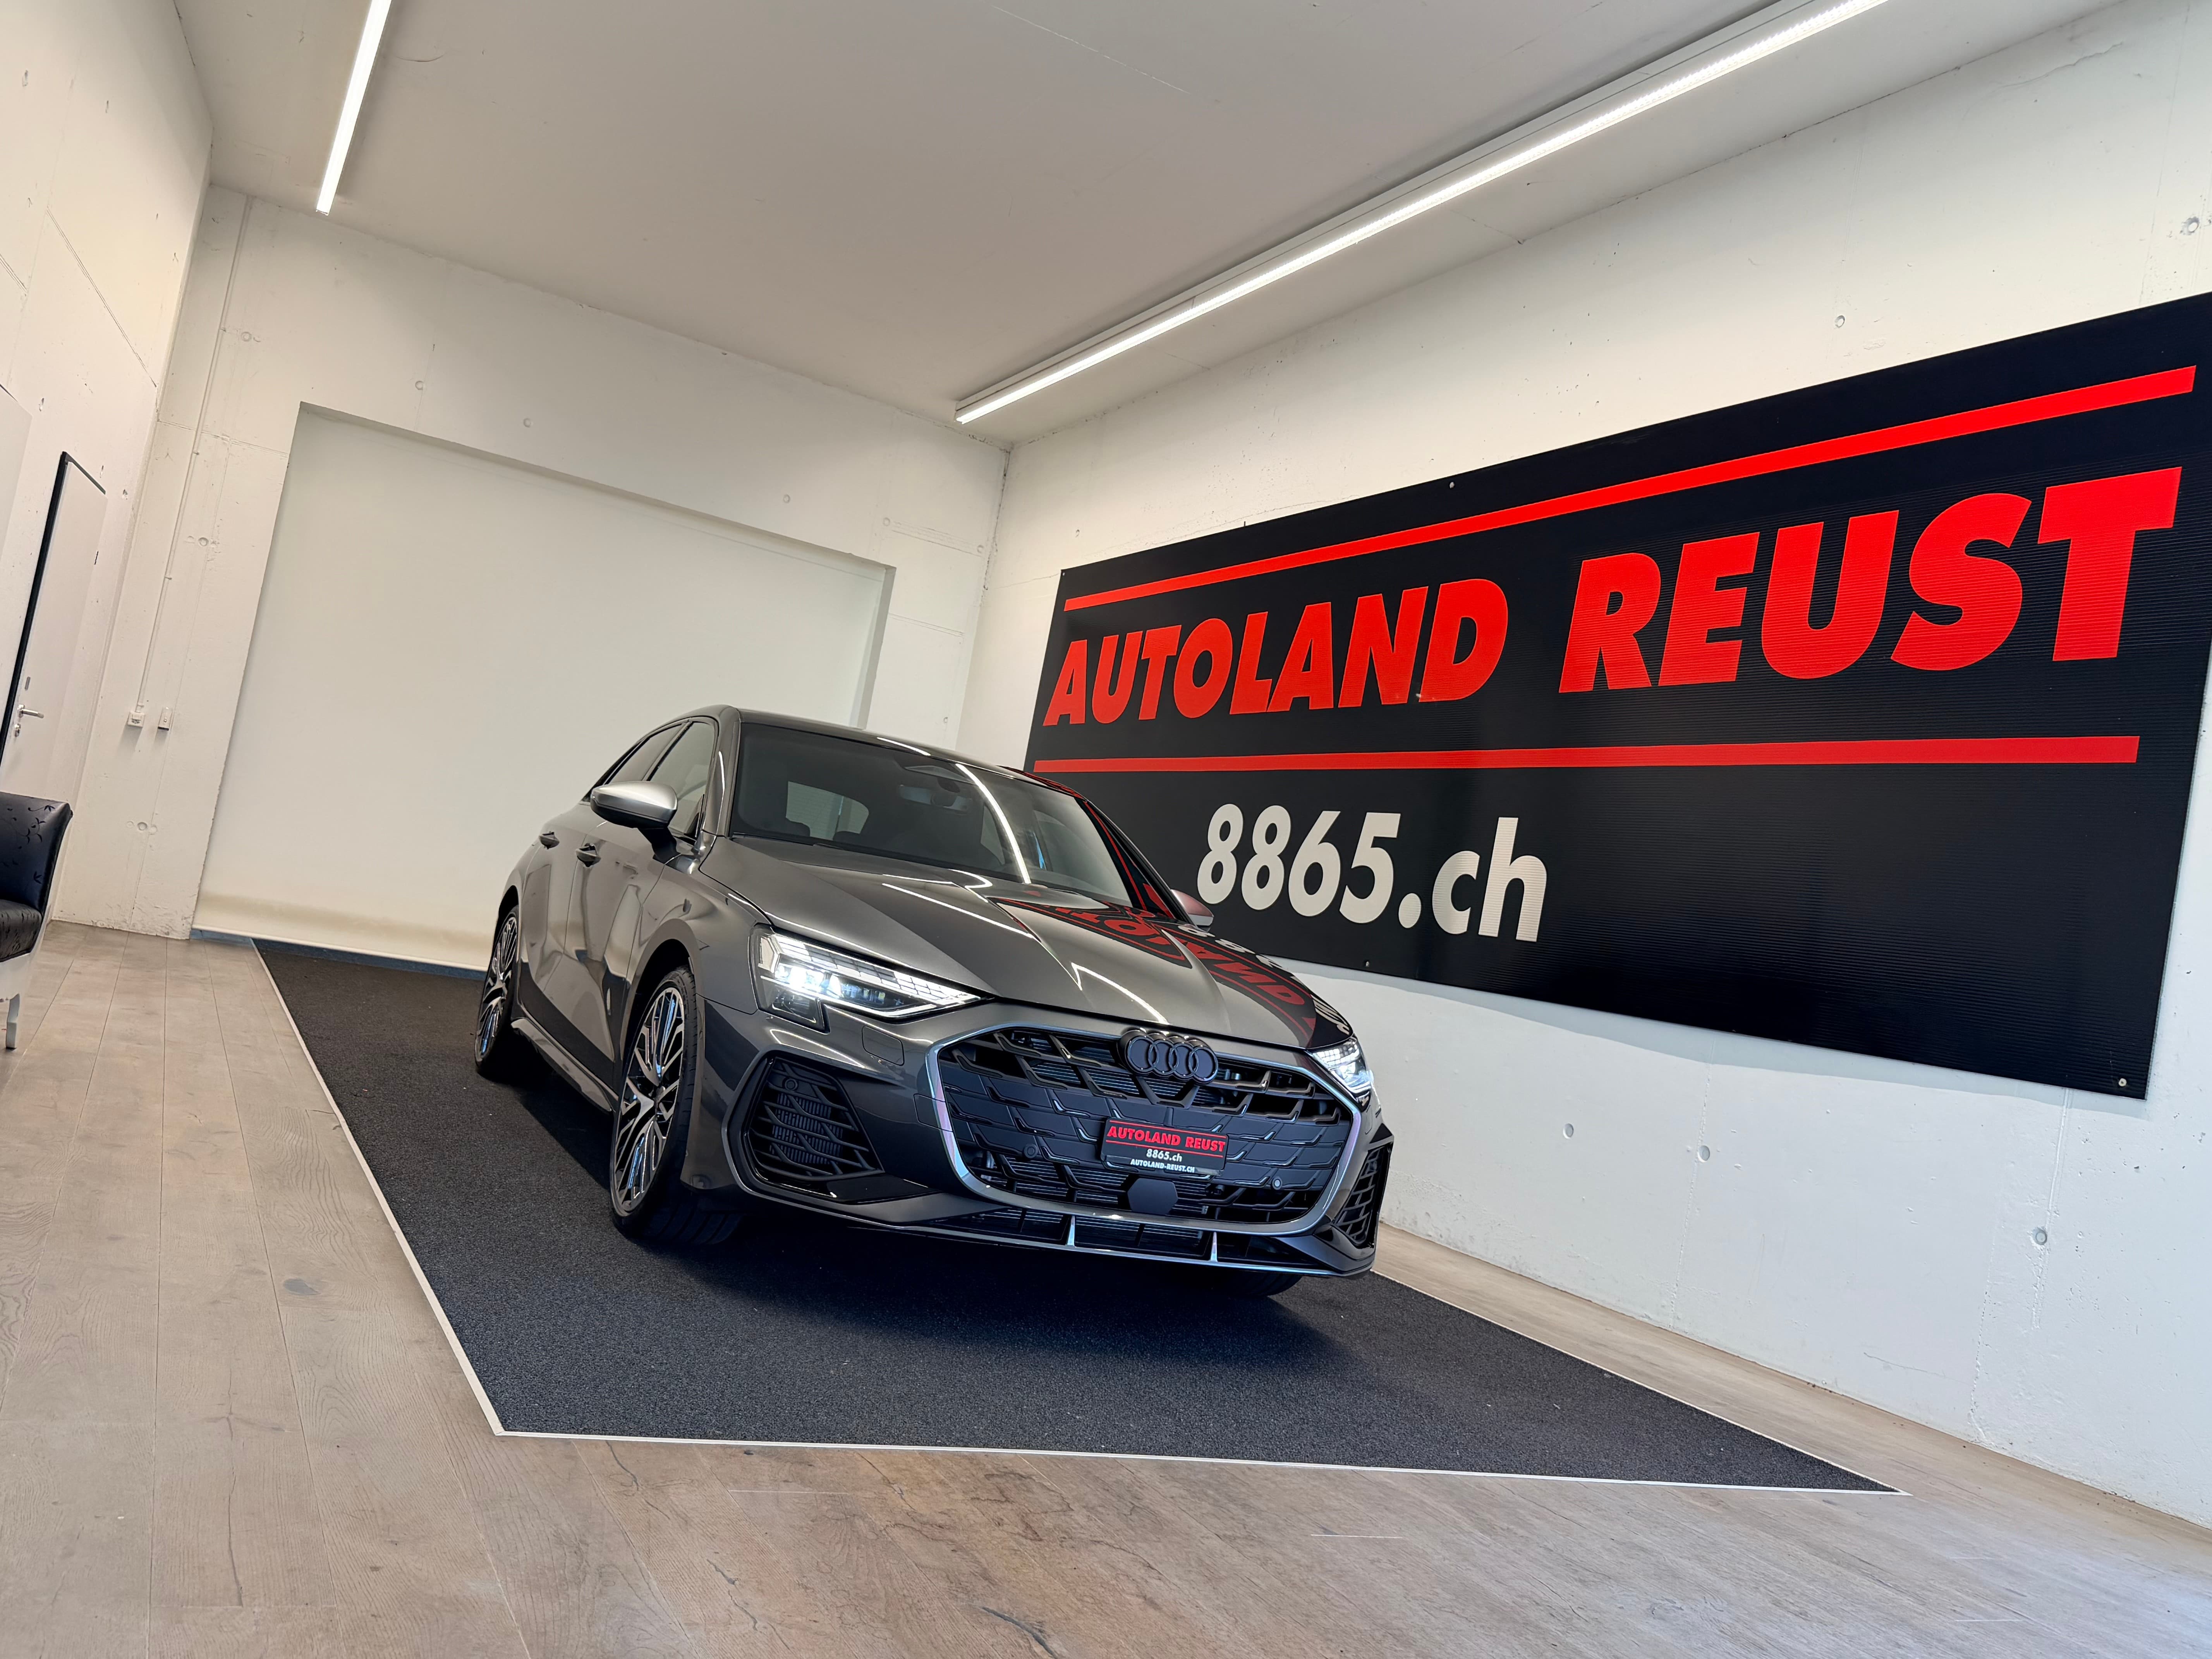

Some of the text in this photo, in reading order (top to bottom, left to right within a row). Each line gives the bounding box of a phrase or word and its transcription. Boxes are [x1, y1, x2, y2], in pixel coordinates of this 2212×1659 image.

[1043, 466, 2183, 727] AUTOLAND REUST
[1196, 803, 1548, 943] 8865.ch
[1107, 1126, 1226, 1152] AUTOLAND REUST
[1130, 1158, 1195, 1173] AUTOLAND-REUST.CH
[1146, 1148, 1183, 1163] 8865.ch
